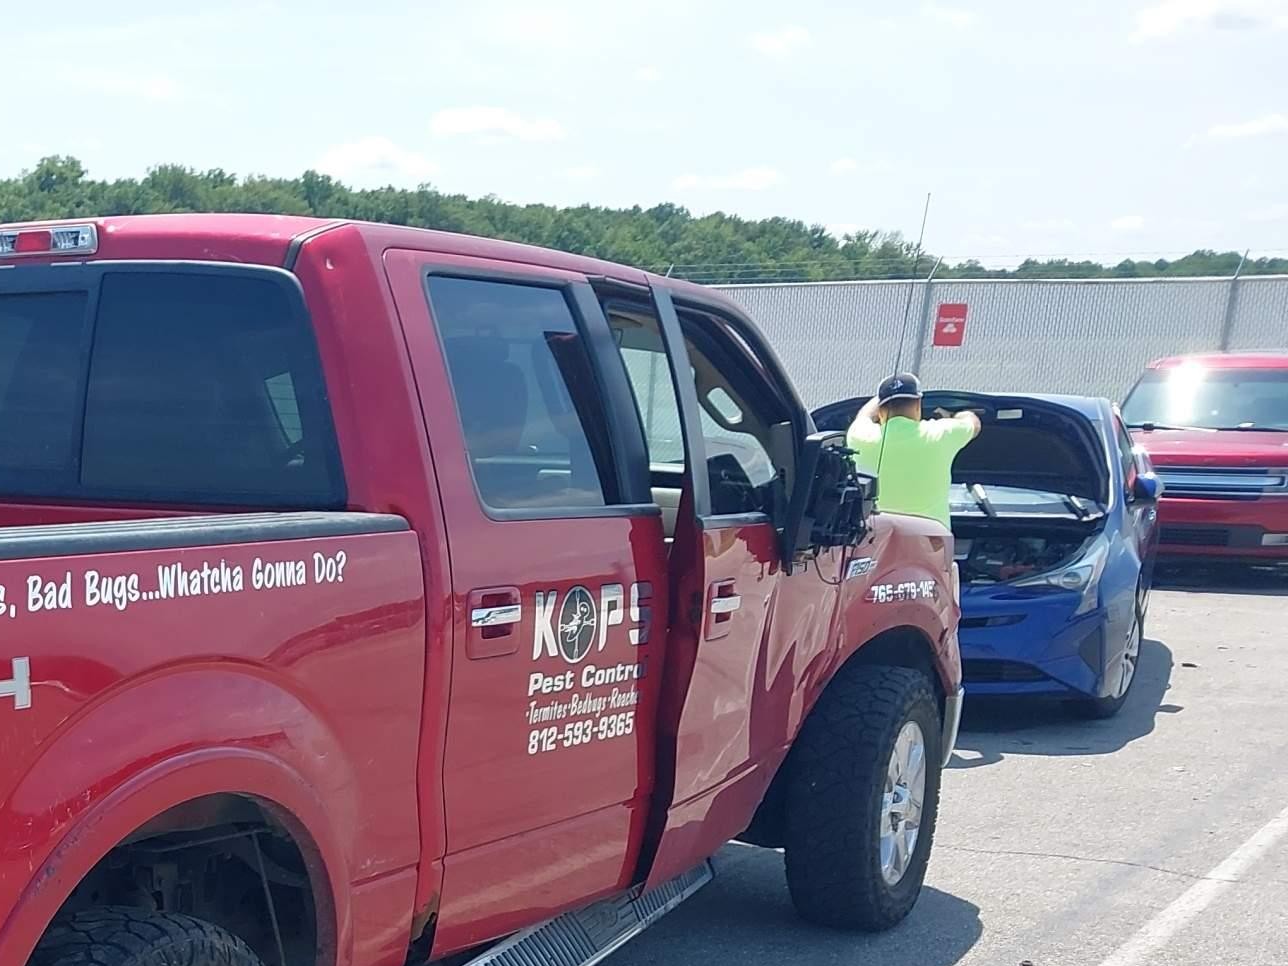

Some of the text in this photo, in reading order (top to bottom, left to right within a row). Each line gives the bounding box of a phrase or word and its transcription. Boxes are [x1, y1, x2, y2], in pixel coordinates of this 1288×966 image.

[27, 571, 72, 613] Bad
[252, 557, 306, 589] Gonna
[314, 551, 347, 584] Do?
[528, 670, 574, 697] Pest
[527, 711, 635, 755] 812-593-9365
